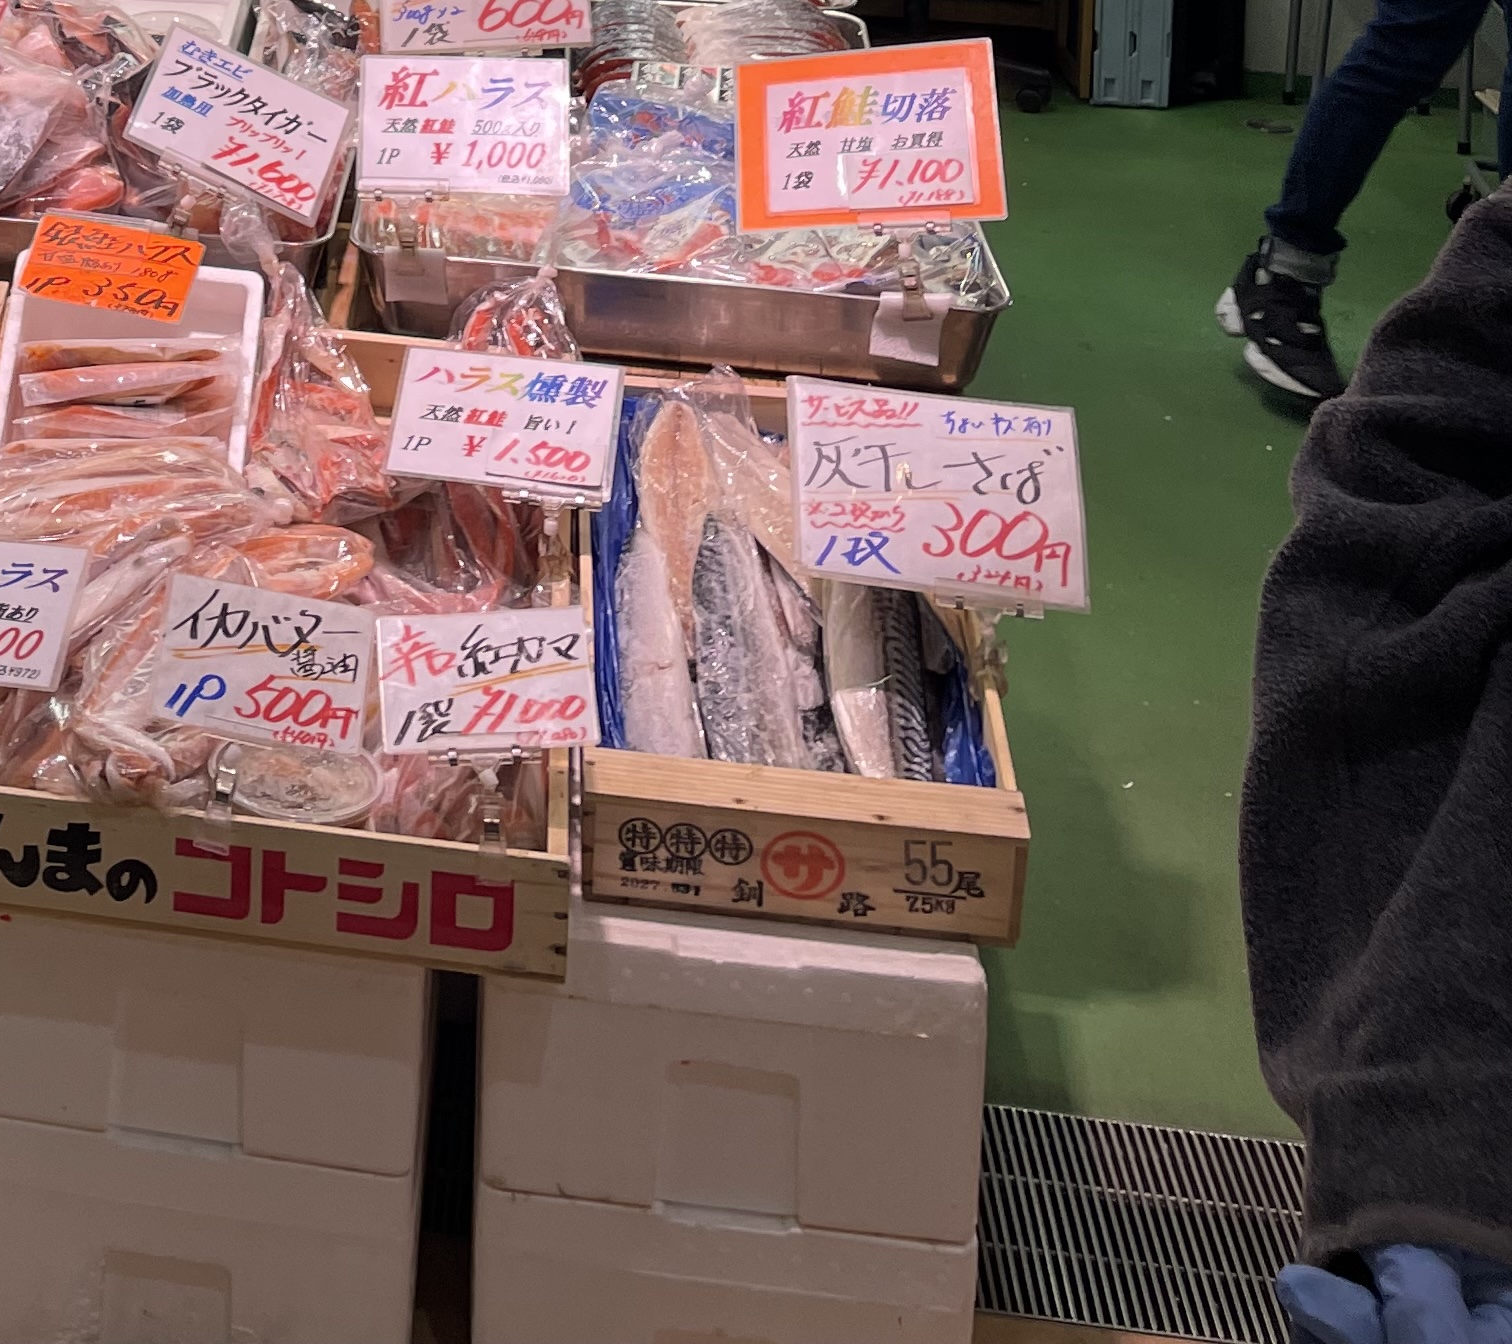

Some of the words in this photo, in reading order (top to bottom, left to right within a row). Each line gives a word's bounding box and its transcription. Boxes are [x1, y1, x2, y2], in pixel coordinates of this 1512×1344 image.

[178, 40, 253, 81] むきエビ
[161, 86, 214, 118] 加熱用
[162, 59, 328, 143] ブラックタイガー
[377, 65, 551, 111] 紅ハラス
[151, 111, 185, 135] 1袋
[382, 118, 455, 135] 天然紅鮭
[777, 85, 958, 133] 紅鮭切落
[376, 148, 401, 166] 1P
[787, 140, 821, 158] 天然
[839, 136, 874, 153] 甘塩
[891, 131, 945, 150] お買得
[781, 171, 814, 191] 1袋
[414, 366, 609, 408] ハラス燻製
[419, 404, 508, 428] 天然紅鮭
[524, 414, 577, 434] 旨い!
[401, 434, 432, 451] 1P
[804, 435, 1065, 505] 灰干しさば
[922, 502, 1072, 587] 300円
[165, 588, 363, 656] イカバター
[289, 647, 360, 682] 醤油
[173, 837, 515, 952] コトシロ
[732, 878, 764, 907] 釧
[837, 892, 876, 916] 路
